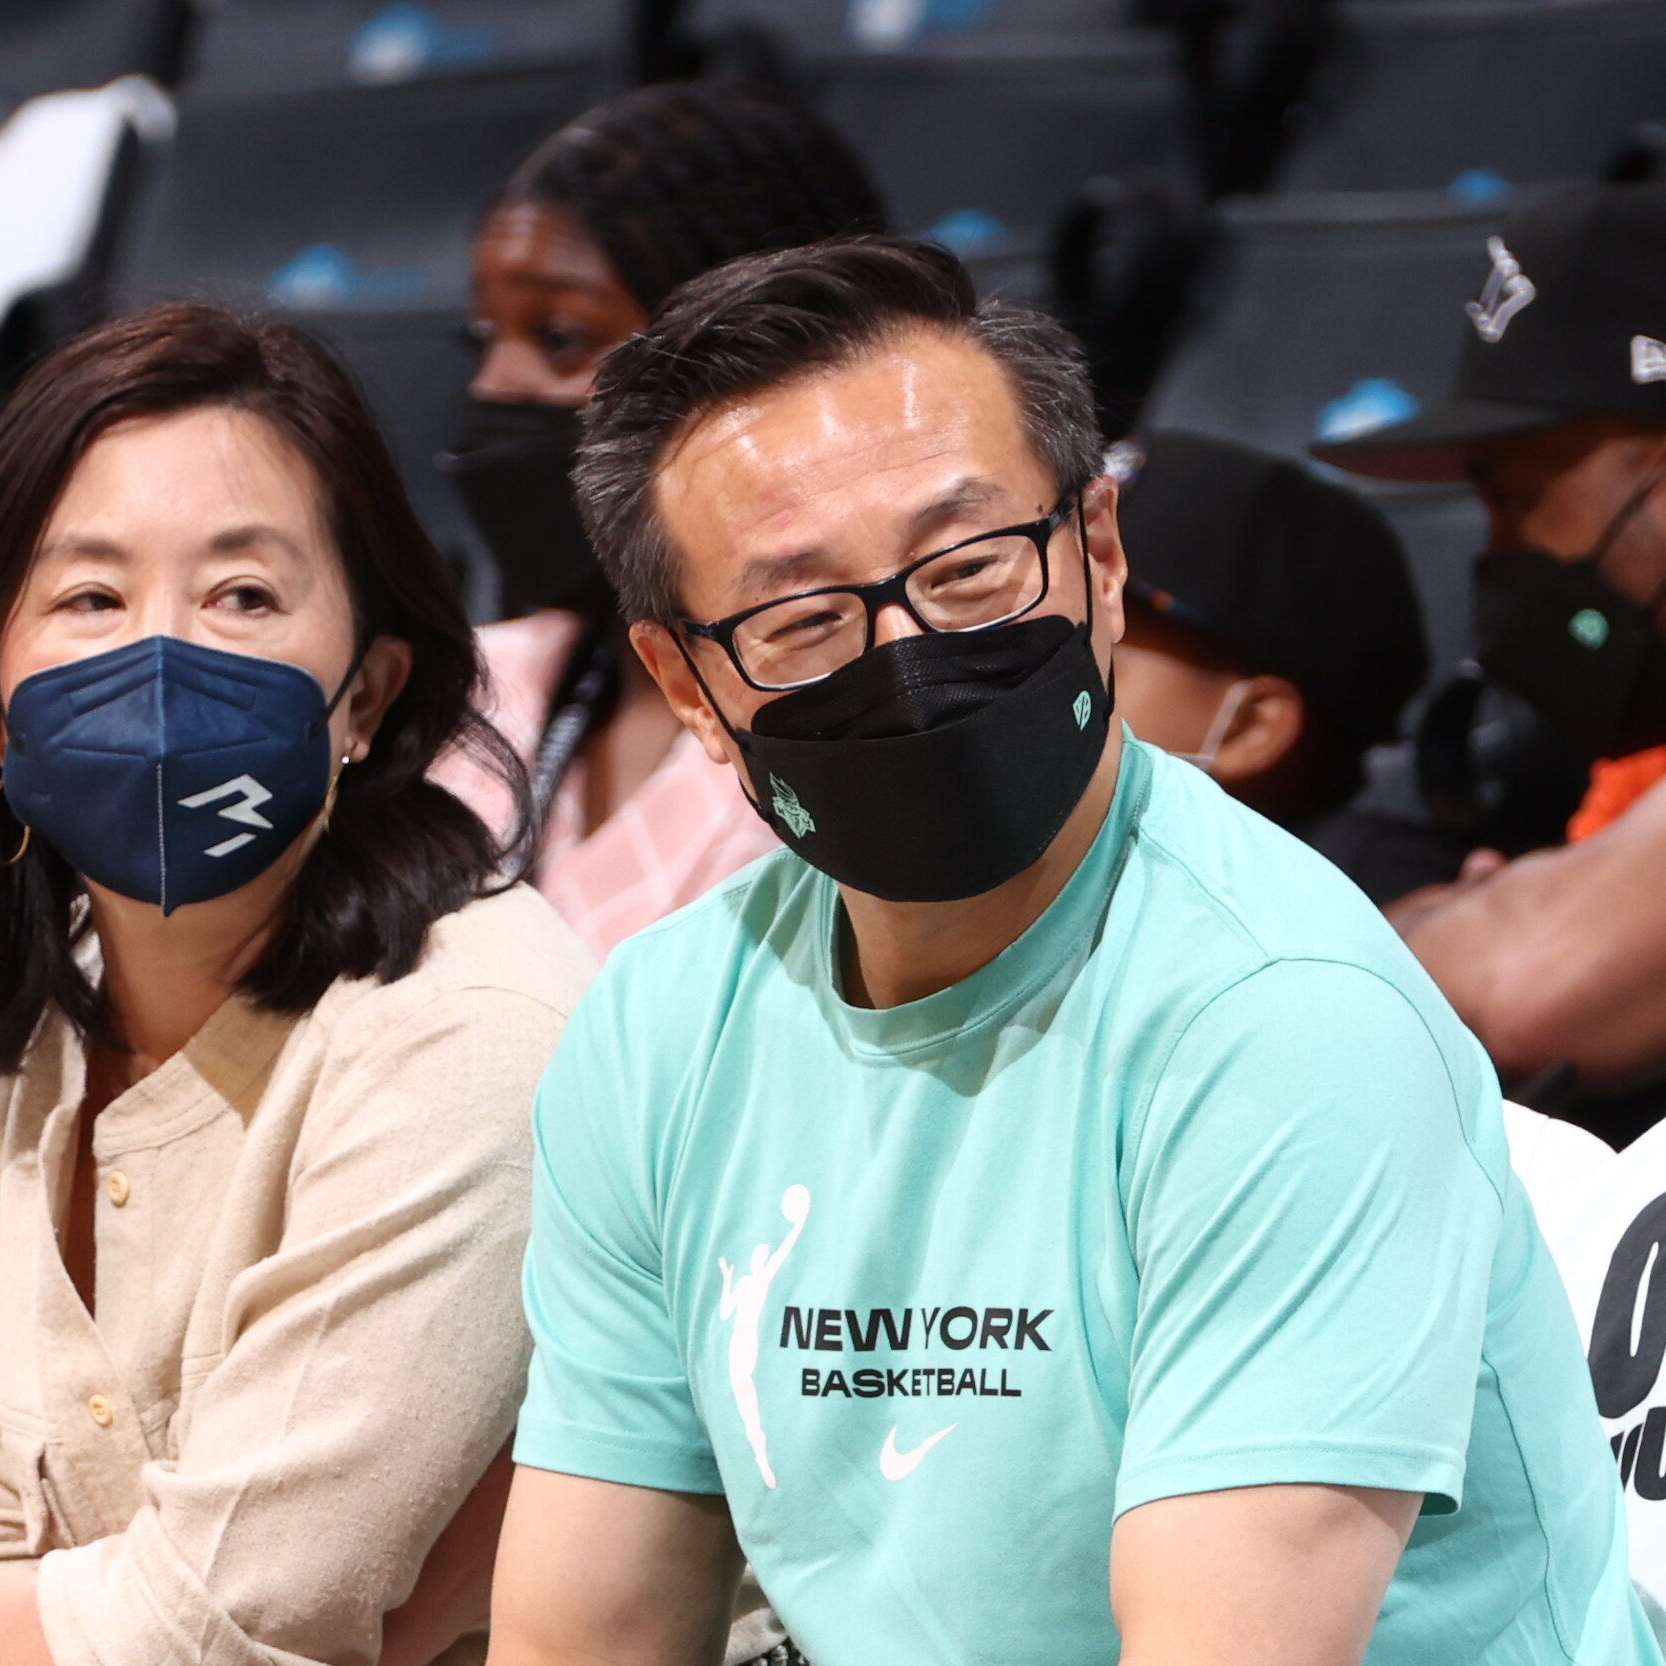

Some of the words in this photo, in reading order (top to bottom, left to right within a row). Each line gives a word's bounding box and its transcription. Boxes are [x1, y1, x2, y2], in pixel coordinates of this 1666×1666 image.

[780, 1306, 911, 1352] NEW
[919, 1306, 1053, 1352] YORK
[800, 1367, 1022, 1398] BASKETBALL
